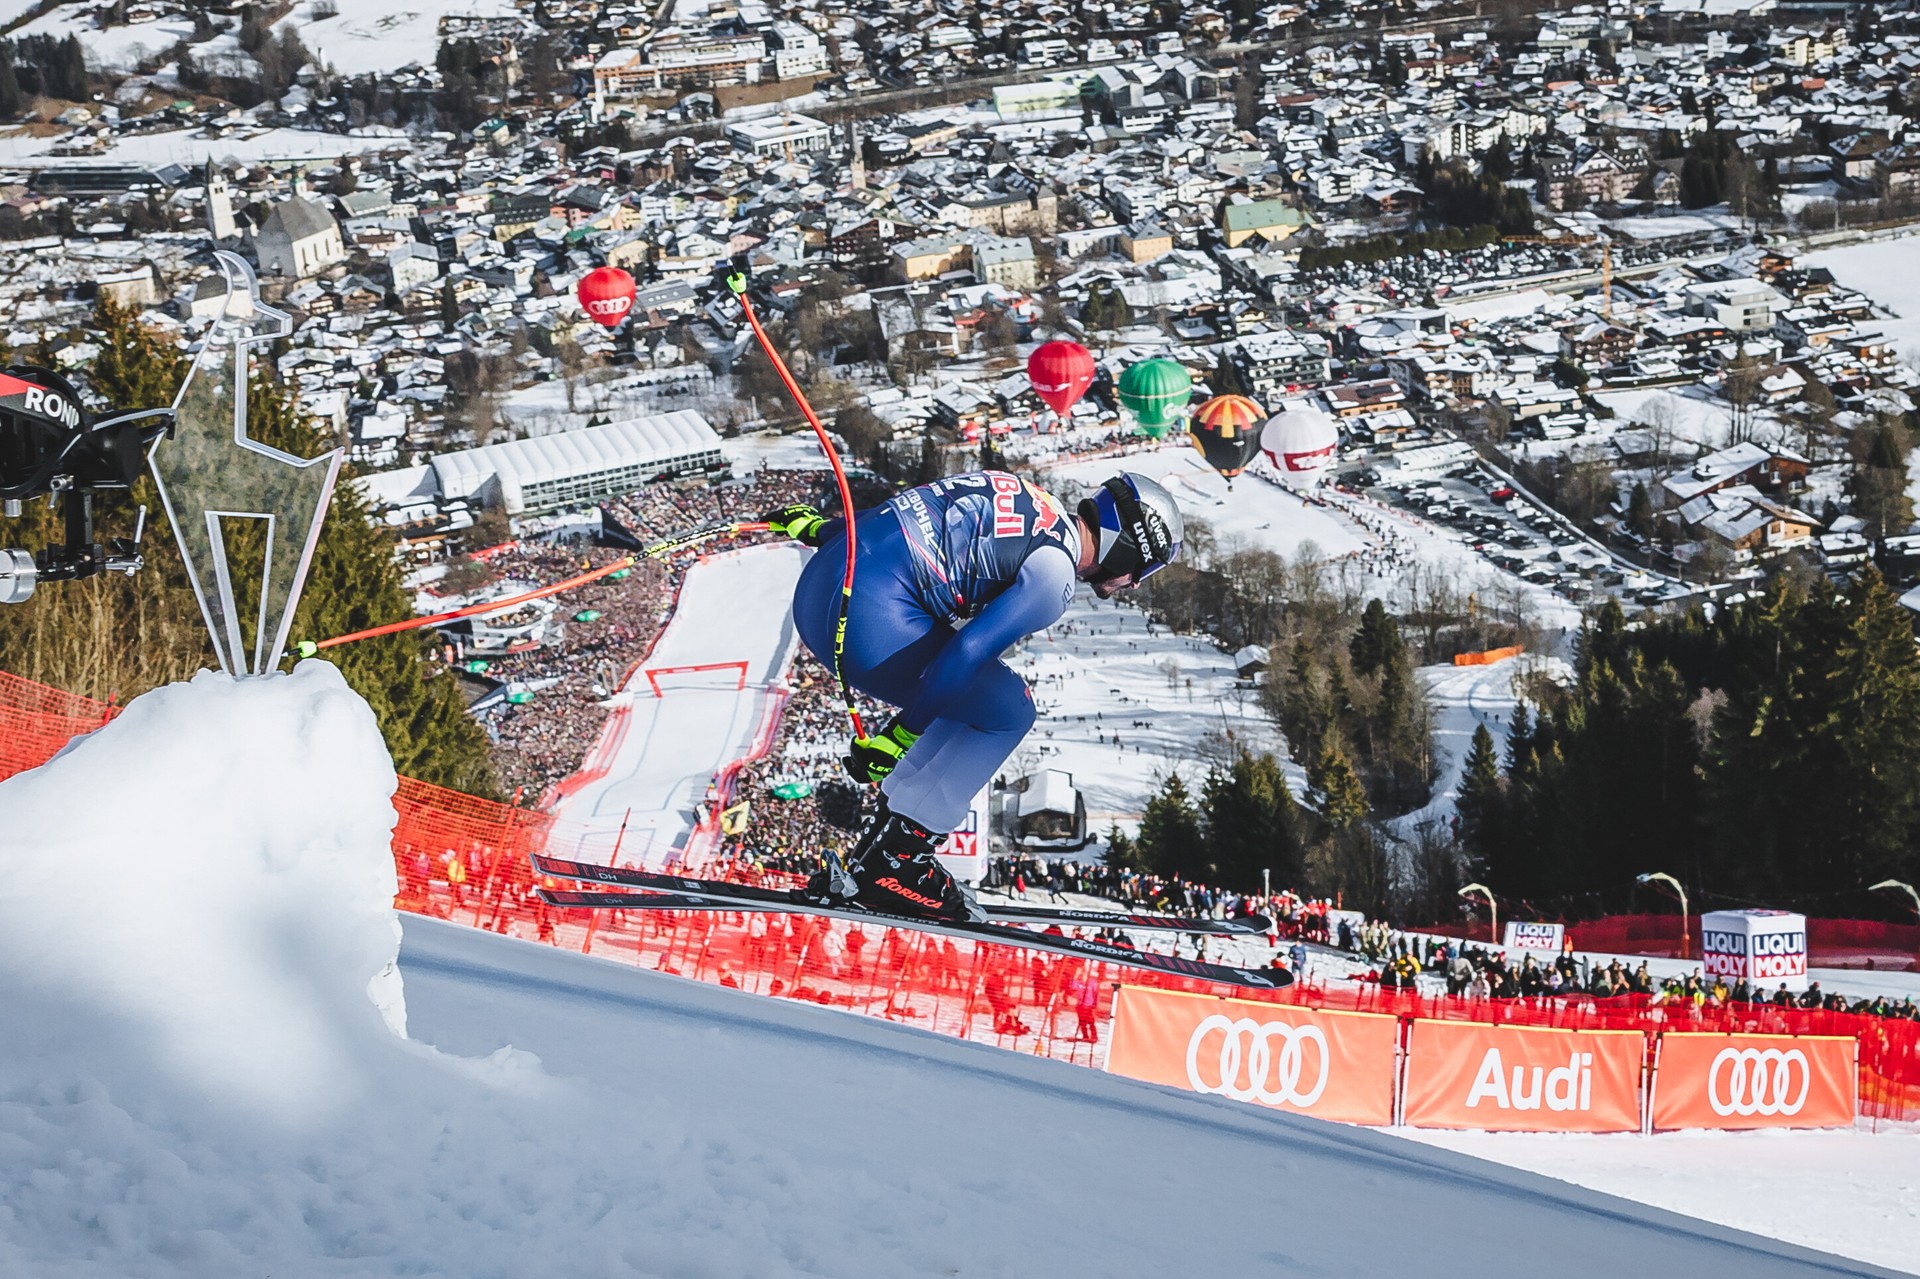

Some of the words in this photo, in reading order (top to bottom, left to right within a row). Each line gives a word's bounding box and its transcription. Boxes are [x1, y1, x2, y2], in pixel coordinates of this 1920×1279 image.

[992, 475, 1023, 536] Bull
[1132, 521, 1153, 563] uvex
[1148, 515, 1168, 549] uvex
[834, 616, 848, 655] LEKI
[598, 872, 618, 881] DH
[875, 876, 944, 910] NORDICA
[1059, 909, 1130, 921] NORDICA
[1515, 935, 1553, 949] MOLY
[1517, 924, 1554, 937] LIQUI
[1070, 938, 1144, 960] NORDICA
[1703, 931, 1745, 955] LIQUI
[1754, 933, 1804, 956] LIQUI
[1704, 952, 1746, 977] MOLY
[1755, 954, 1807, 978] MOLY
[1464, 1047, 1593, 1112] Audi
